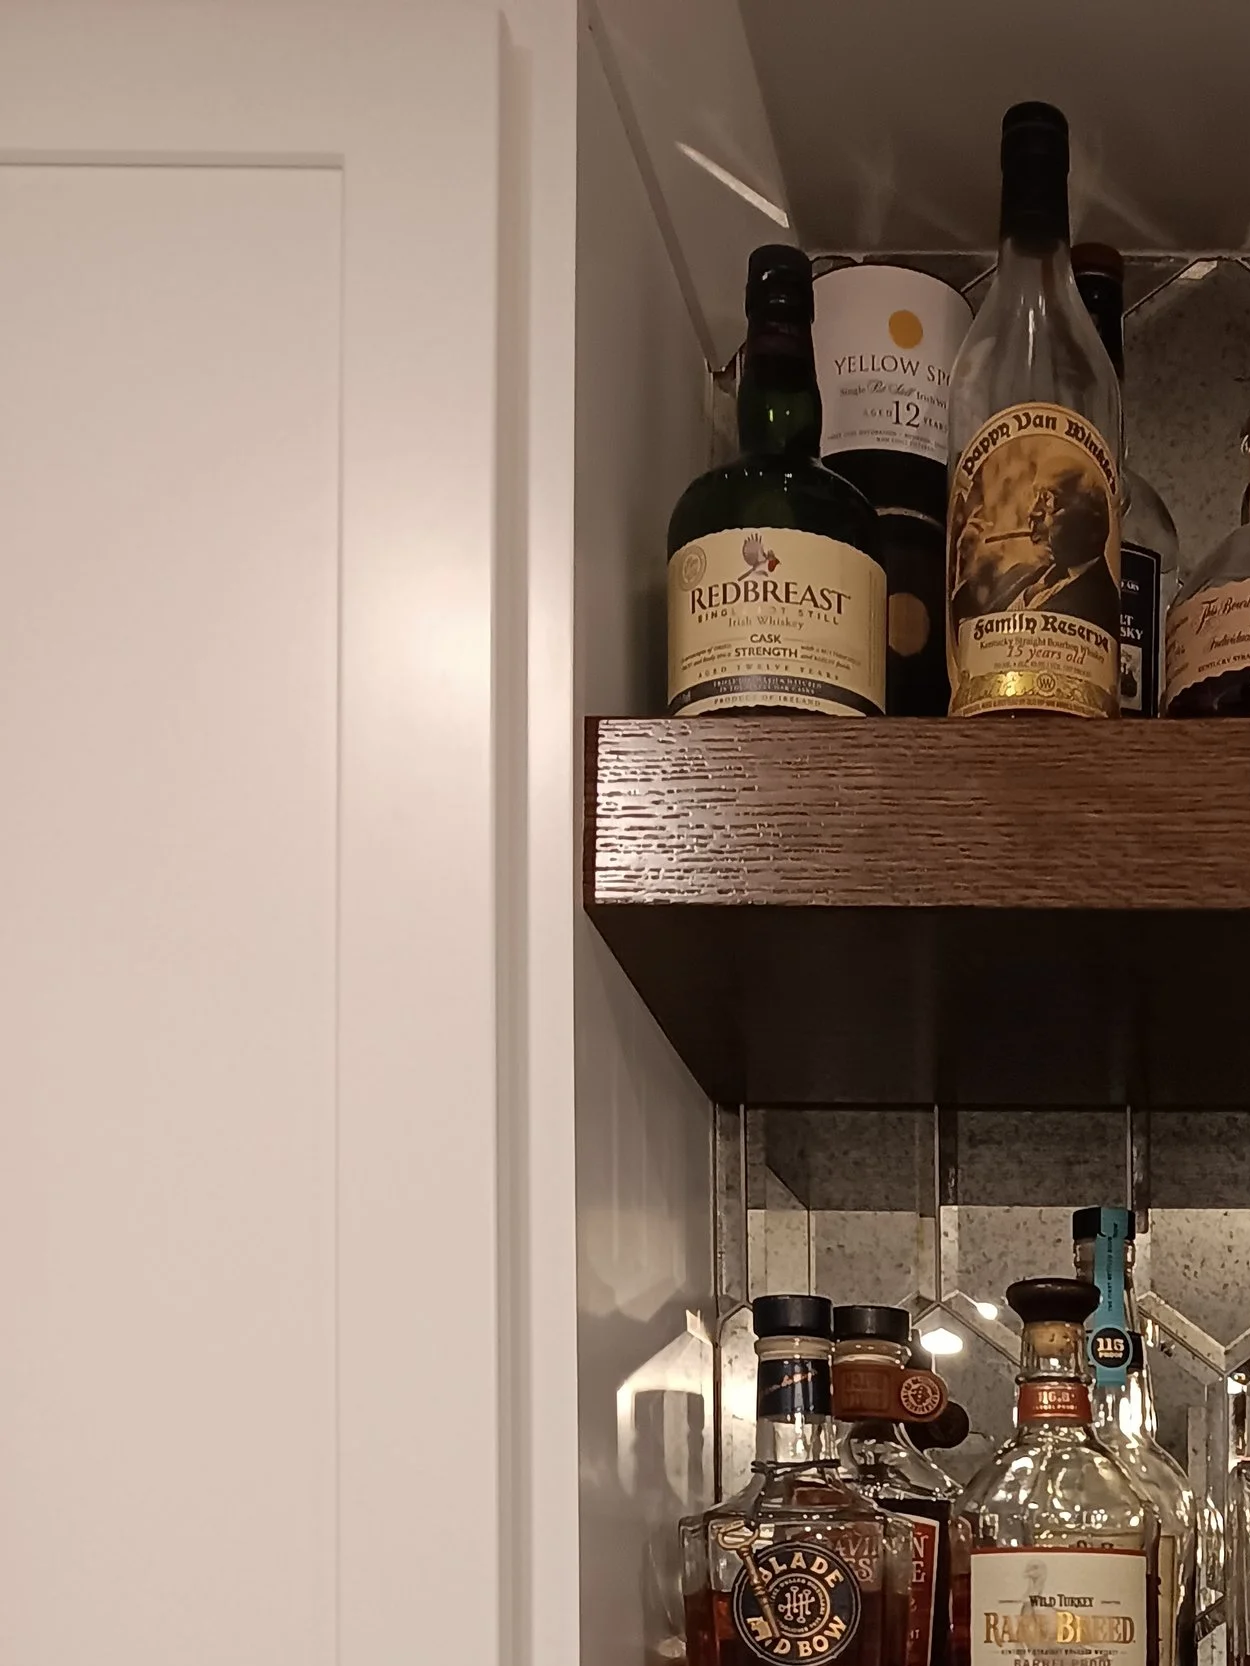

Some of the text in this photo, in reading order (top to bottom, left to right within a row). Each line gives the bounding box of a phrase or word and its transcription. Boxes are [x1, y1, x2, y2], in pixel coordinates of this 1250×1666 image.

[834, 354, 920, 376] YELLOW
[892, 400, 920, 428] 12
[1013, 412, 1057, 431] Van
[691, 580, 848, 615] REDBREAST
[728, 616, 804, 630] Irish Whiskey
[798, 609, 839, 625] STILL
[750, 633, 782, 644] CASK
[973, 613, 1110, 653] Family Reserve
[1015, 637, 1046, 648] Straight
[735, 647, 798, 658] STRENGTH
[1006, 646, 1086, 665] 15 years old
[759, 1551, 845, 1589] BLADE
[1029, 1594, 1094, 1608] WILD TURKEY
[796, 1615, 848, 1657] BOW
